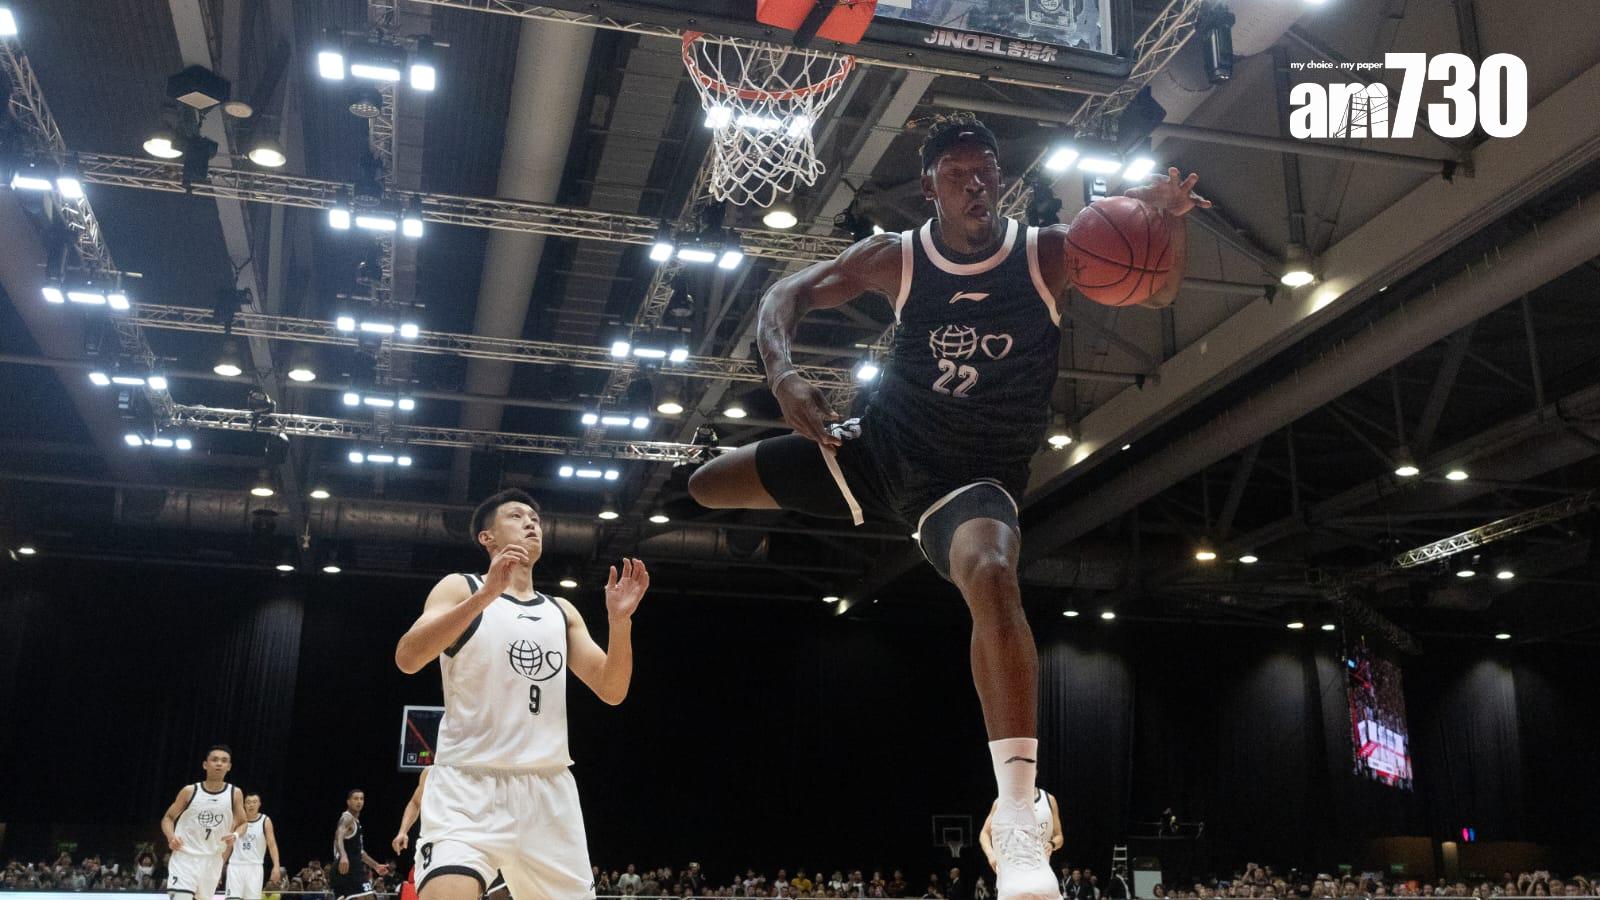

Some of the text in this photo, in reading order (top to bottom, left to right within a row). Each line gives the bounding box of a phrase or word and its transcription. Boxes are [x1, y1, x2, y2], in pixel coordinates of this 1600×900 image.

[924, 29, 1007, 55] JINOEL
[932, 359, 979, 397] 22
[529, 684, 540, 715] 9
[205, 828, 212, 840] 7
[420, 842, 433, 870] 9
[172, 876, 178, 885] 7
